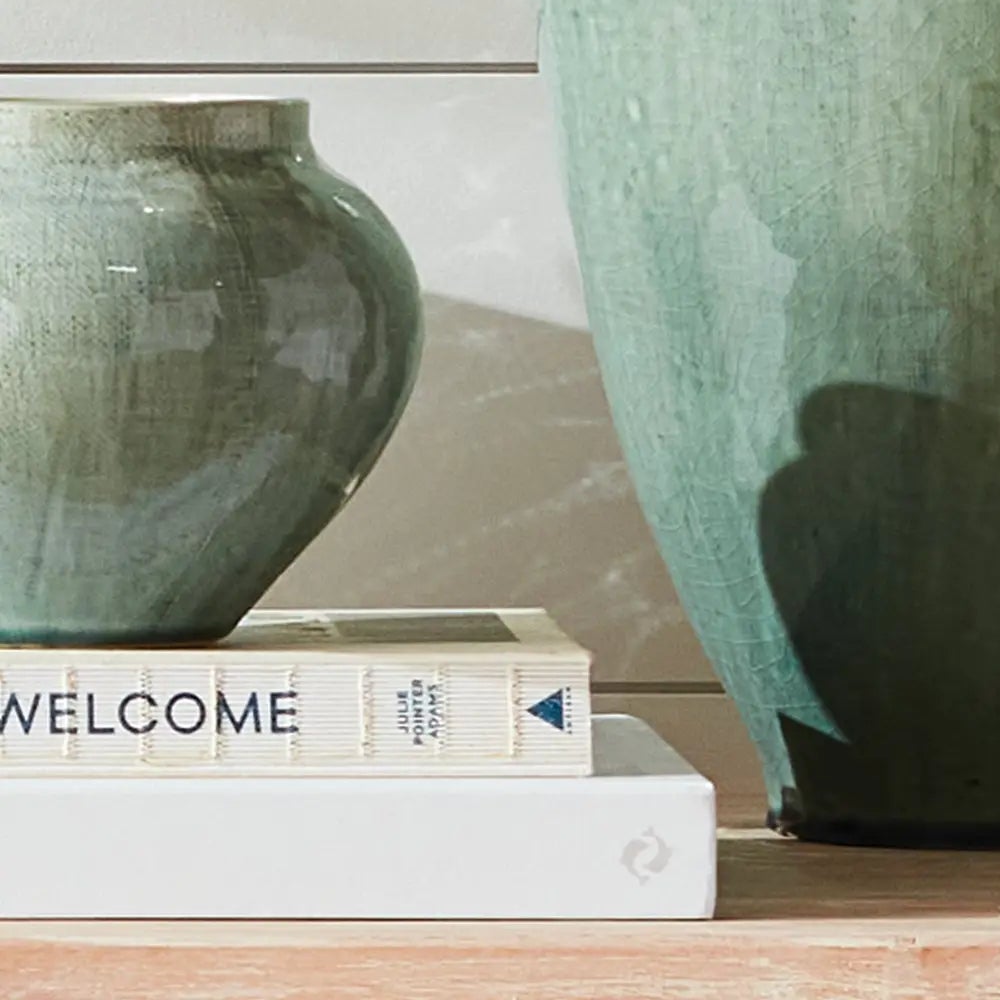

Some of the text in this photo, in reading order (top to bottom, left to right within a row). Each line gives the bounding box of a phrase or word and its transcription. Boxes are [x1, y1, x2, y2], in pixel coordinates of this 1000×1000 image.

[0, 692, 298, 735] WELCOME
[397, 691, 409, 734] JULIE
[412, 679, 424, 745] POINTER
[428, 684, 443, 738] ADAMS
